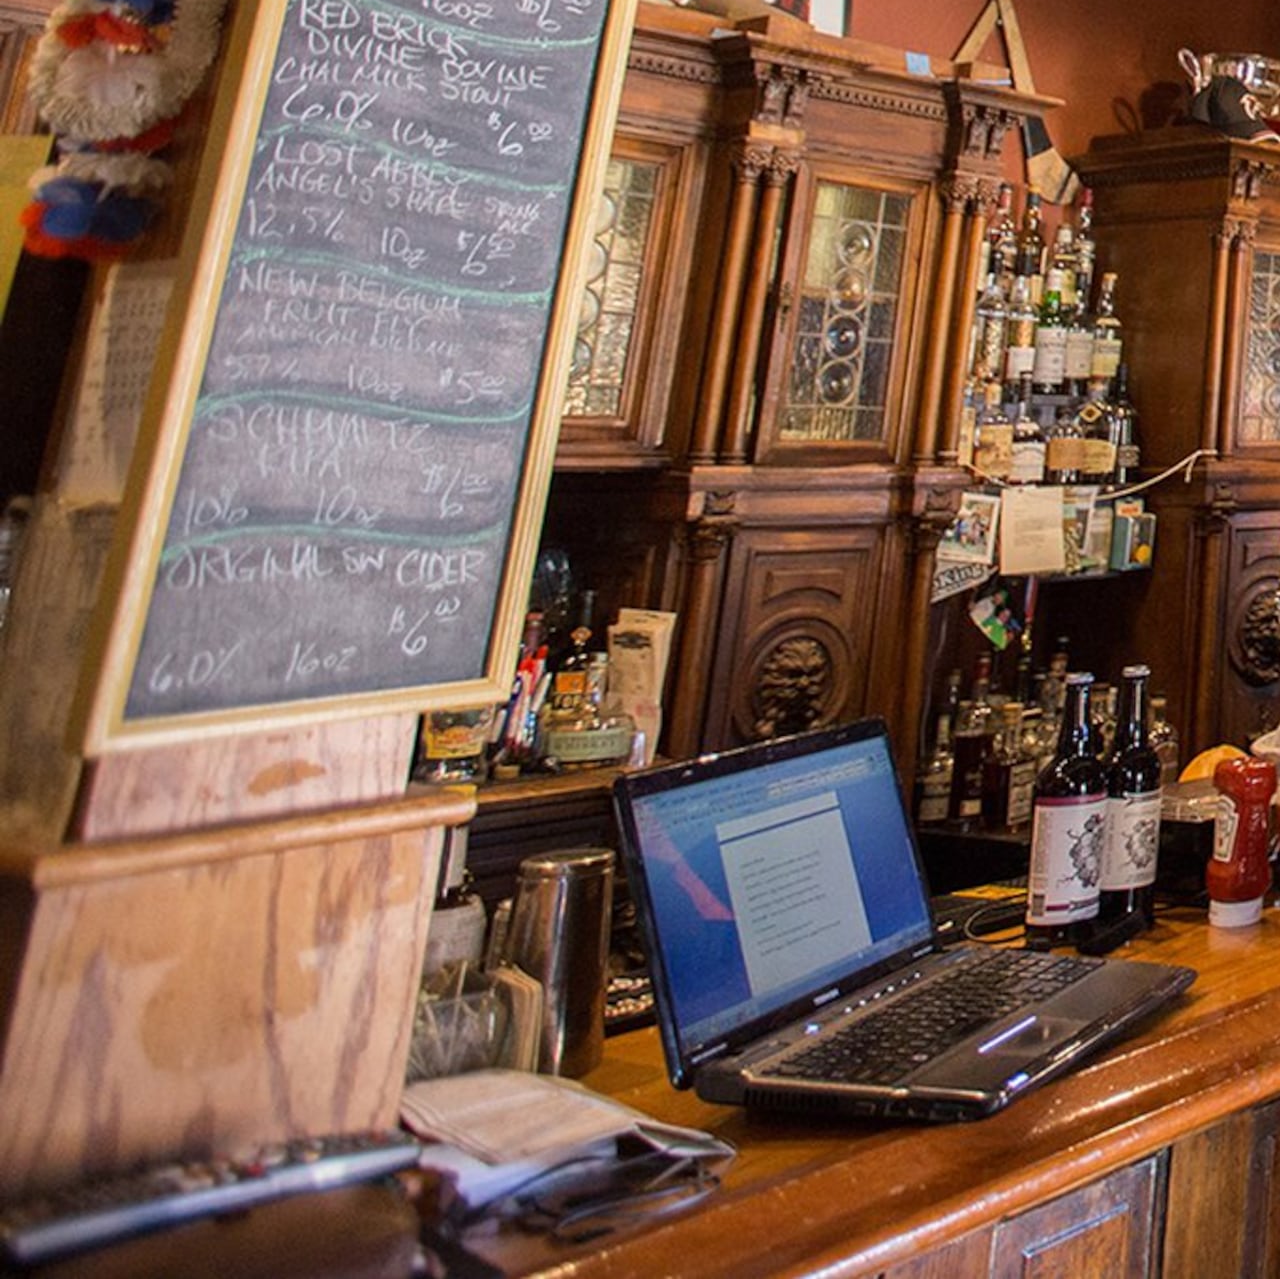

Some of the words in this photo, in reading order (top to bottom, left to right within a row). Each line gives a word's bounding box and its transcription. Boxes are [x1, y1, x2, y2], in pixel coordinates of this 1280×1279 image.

[308, 28, 426, 72] DIVINE
[273, 135, 365, 174] LOST
[239, 262, 319, 297] NEW
[264, 298, 360, 325] FRUIT
[397, 549, 484, 591] CIDER
